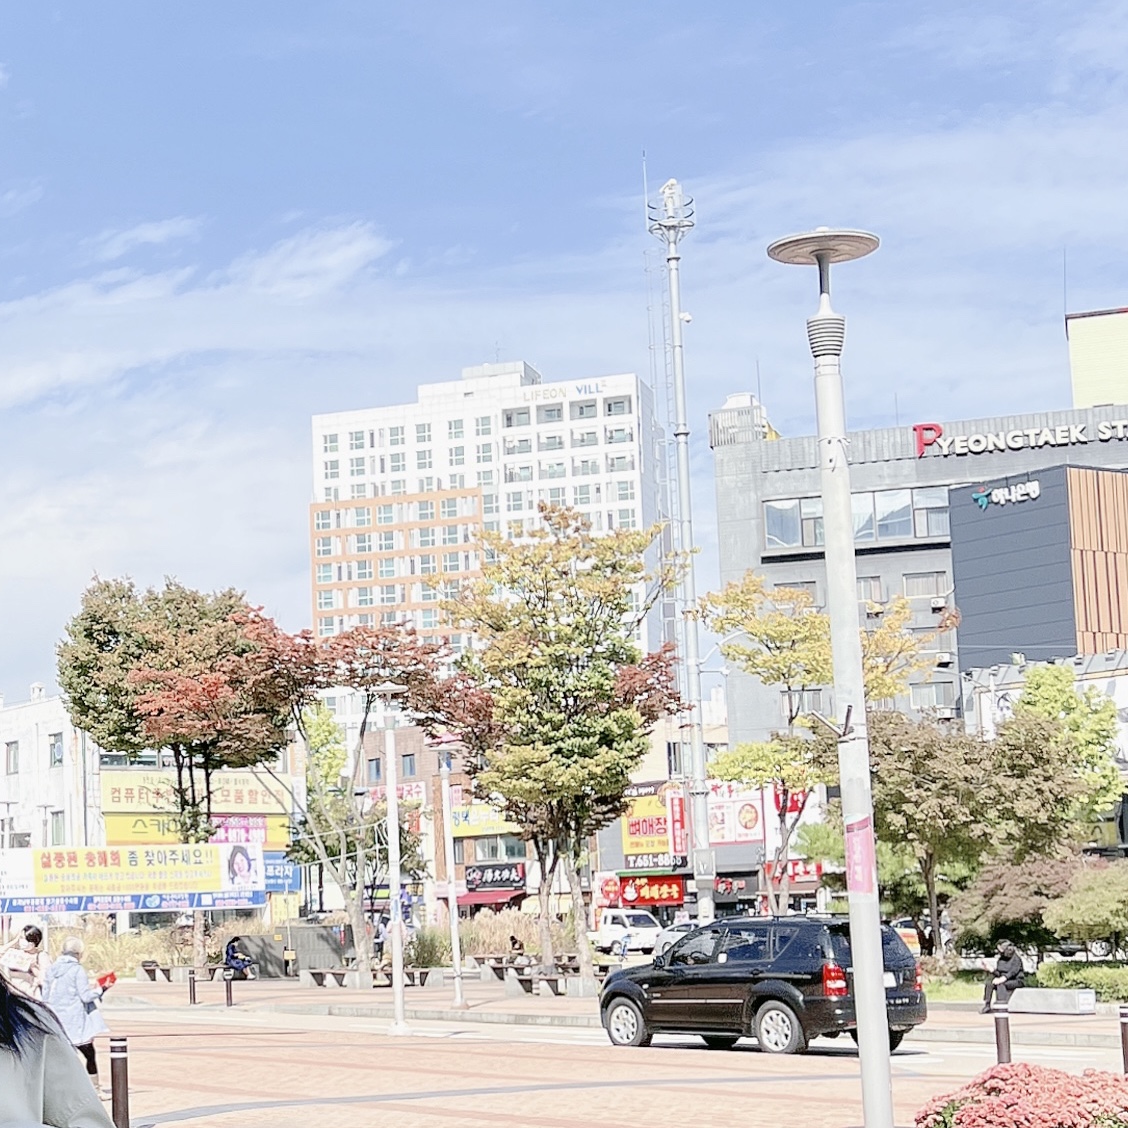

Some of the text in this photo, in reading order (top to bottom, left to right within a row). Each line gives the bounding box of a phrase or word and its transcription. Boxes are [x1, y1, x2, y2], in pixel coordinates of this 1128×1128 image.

[523, 387, 567, 402] LIFEON
[913, 419, 1128, 459] PYEONGTAEK ST
